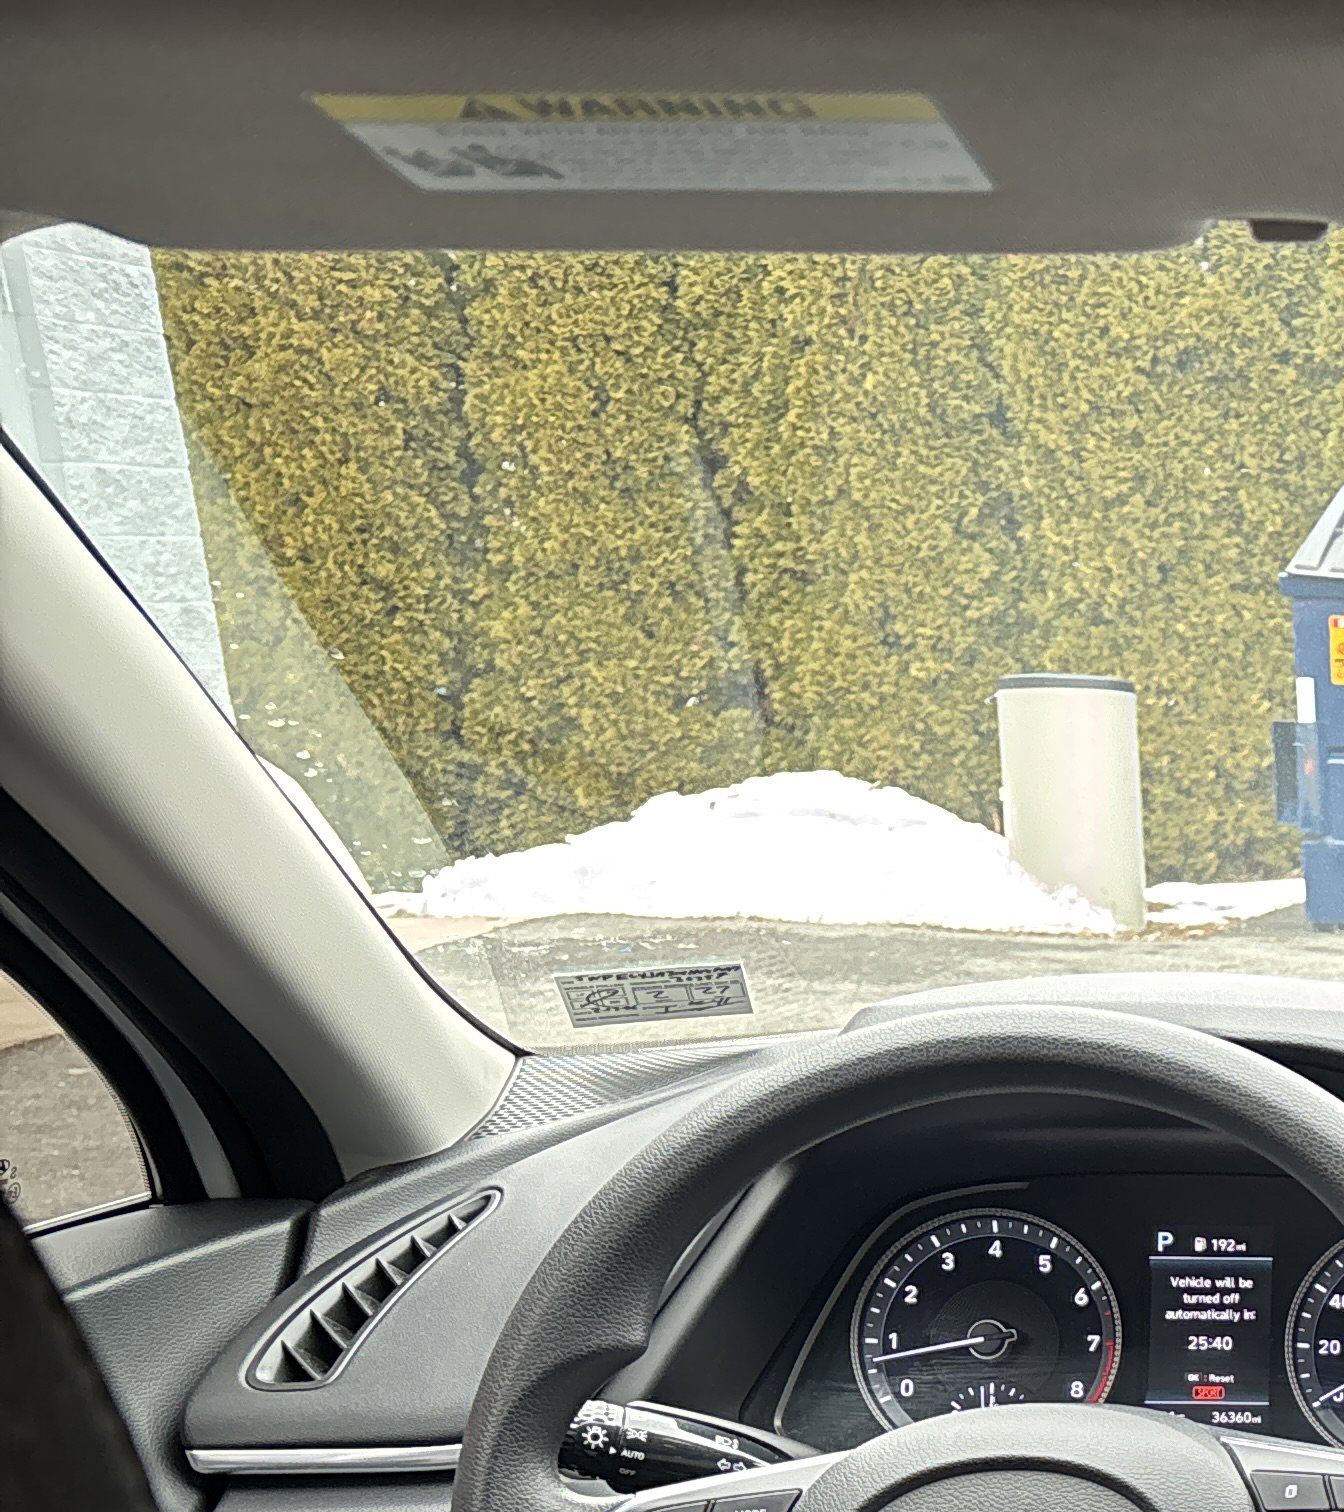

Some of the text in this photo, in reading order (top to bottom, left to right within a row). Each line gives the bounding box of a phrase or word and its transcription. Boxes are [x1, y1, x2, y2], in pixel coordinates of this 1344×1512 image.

[518, 97, 817, 119] WARNING
[988, 1239, 1003, 1258] 4
[1157, 1231, 1174, 1252] P
[941, 1251, 955, 1271] 3
[1038, 1254, 1052, 1273] 5
[1169, 1276, 1254, 1289] Vehicle will be
[904, 1285, 919, 1305] 2
[1074, 1287, 1089, 1307] 6
[1182, 1292, 1240, 1304] turned off
[1164, 1308, 1241, 1322] automatically
[888, 1332, 898, 1350] 1
[1086, 1334, 1101, 1352] 7
[1187, 1335, 1233, 1351] 25:40
[1318, 1339, 1341, 1356] 20
[900, 1378, 914, 1397] 0
[1208, 1374, 1235, 1383] Reset
[1070, 1380, 1084, 1398] 8
[620, 1449, 646, 1461] AUTO
[618, 1467, 637, 1477] OFF
